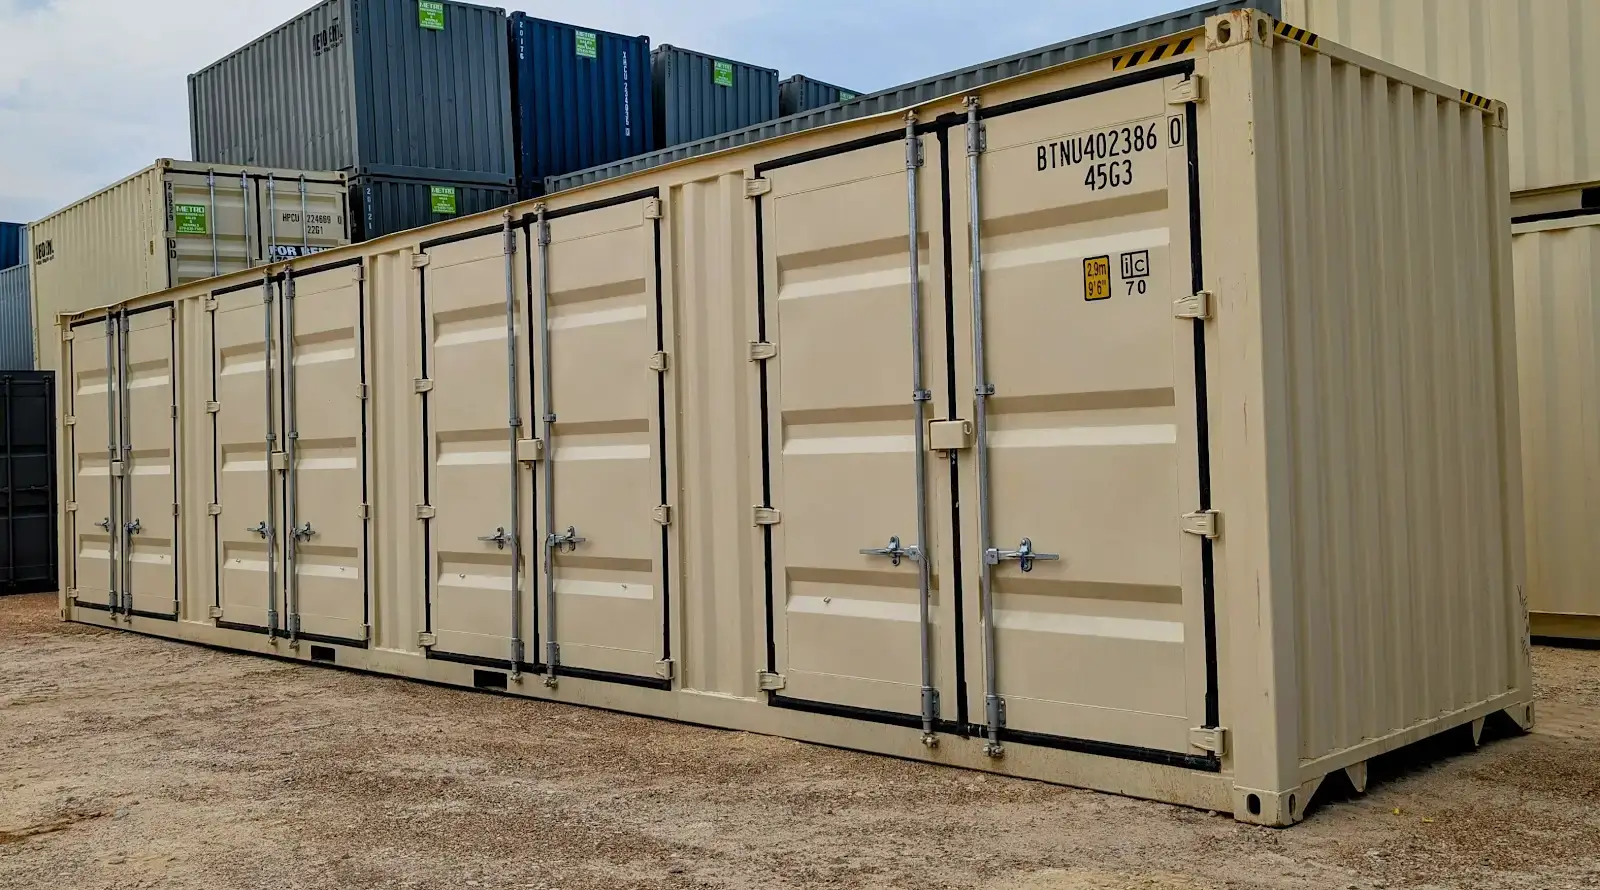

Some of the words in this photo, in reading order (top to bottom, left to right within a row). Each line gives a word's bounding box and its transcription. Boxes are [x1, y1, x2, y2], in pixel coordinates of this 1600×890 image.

[419, 2, 444, 10] METRO
[1037, 122, 1157, 171] BTNU402386
[1169, 117, 1181, 145] 0
[1084, 159, 1133, 191] 45G3
[282, 213, 300, 222] HPCU
[307, 225, 323, 234] 22G1
[269, 246, 297, 256] FOR
[1087, 262, 1107, 279] 2,9m
[1125, 280, 1146, 296] 70
